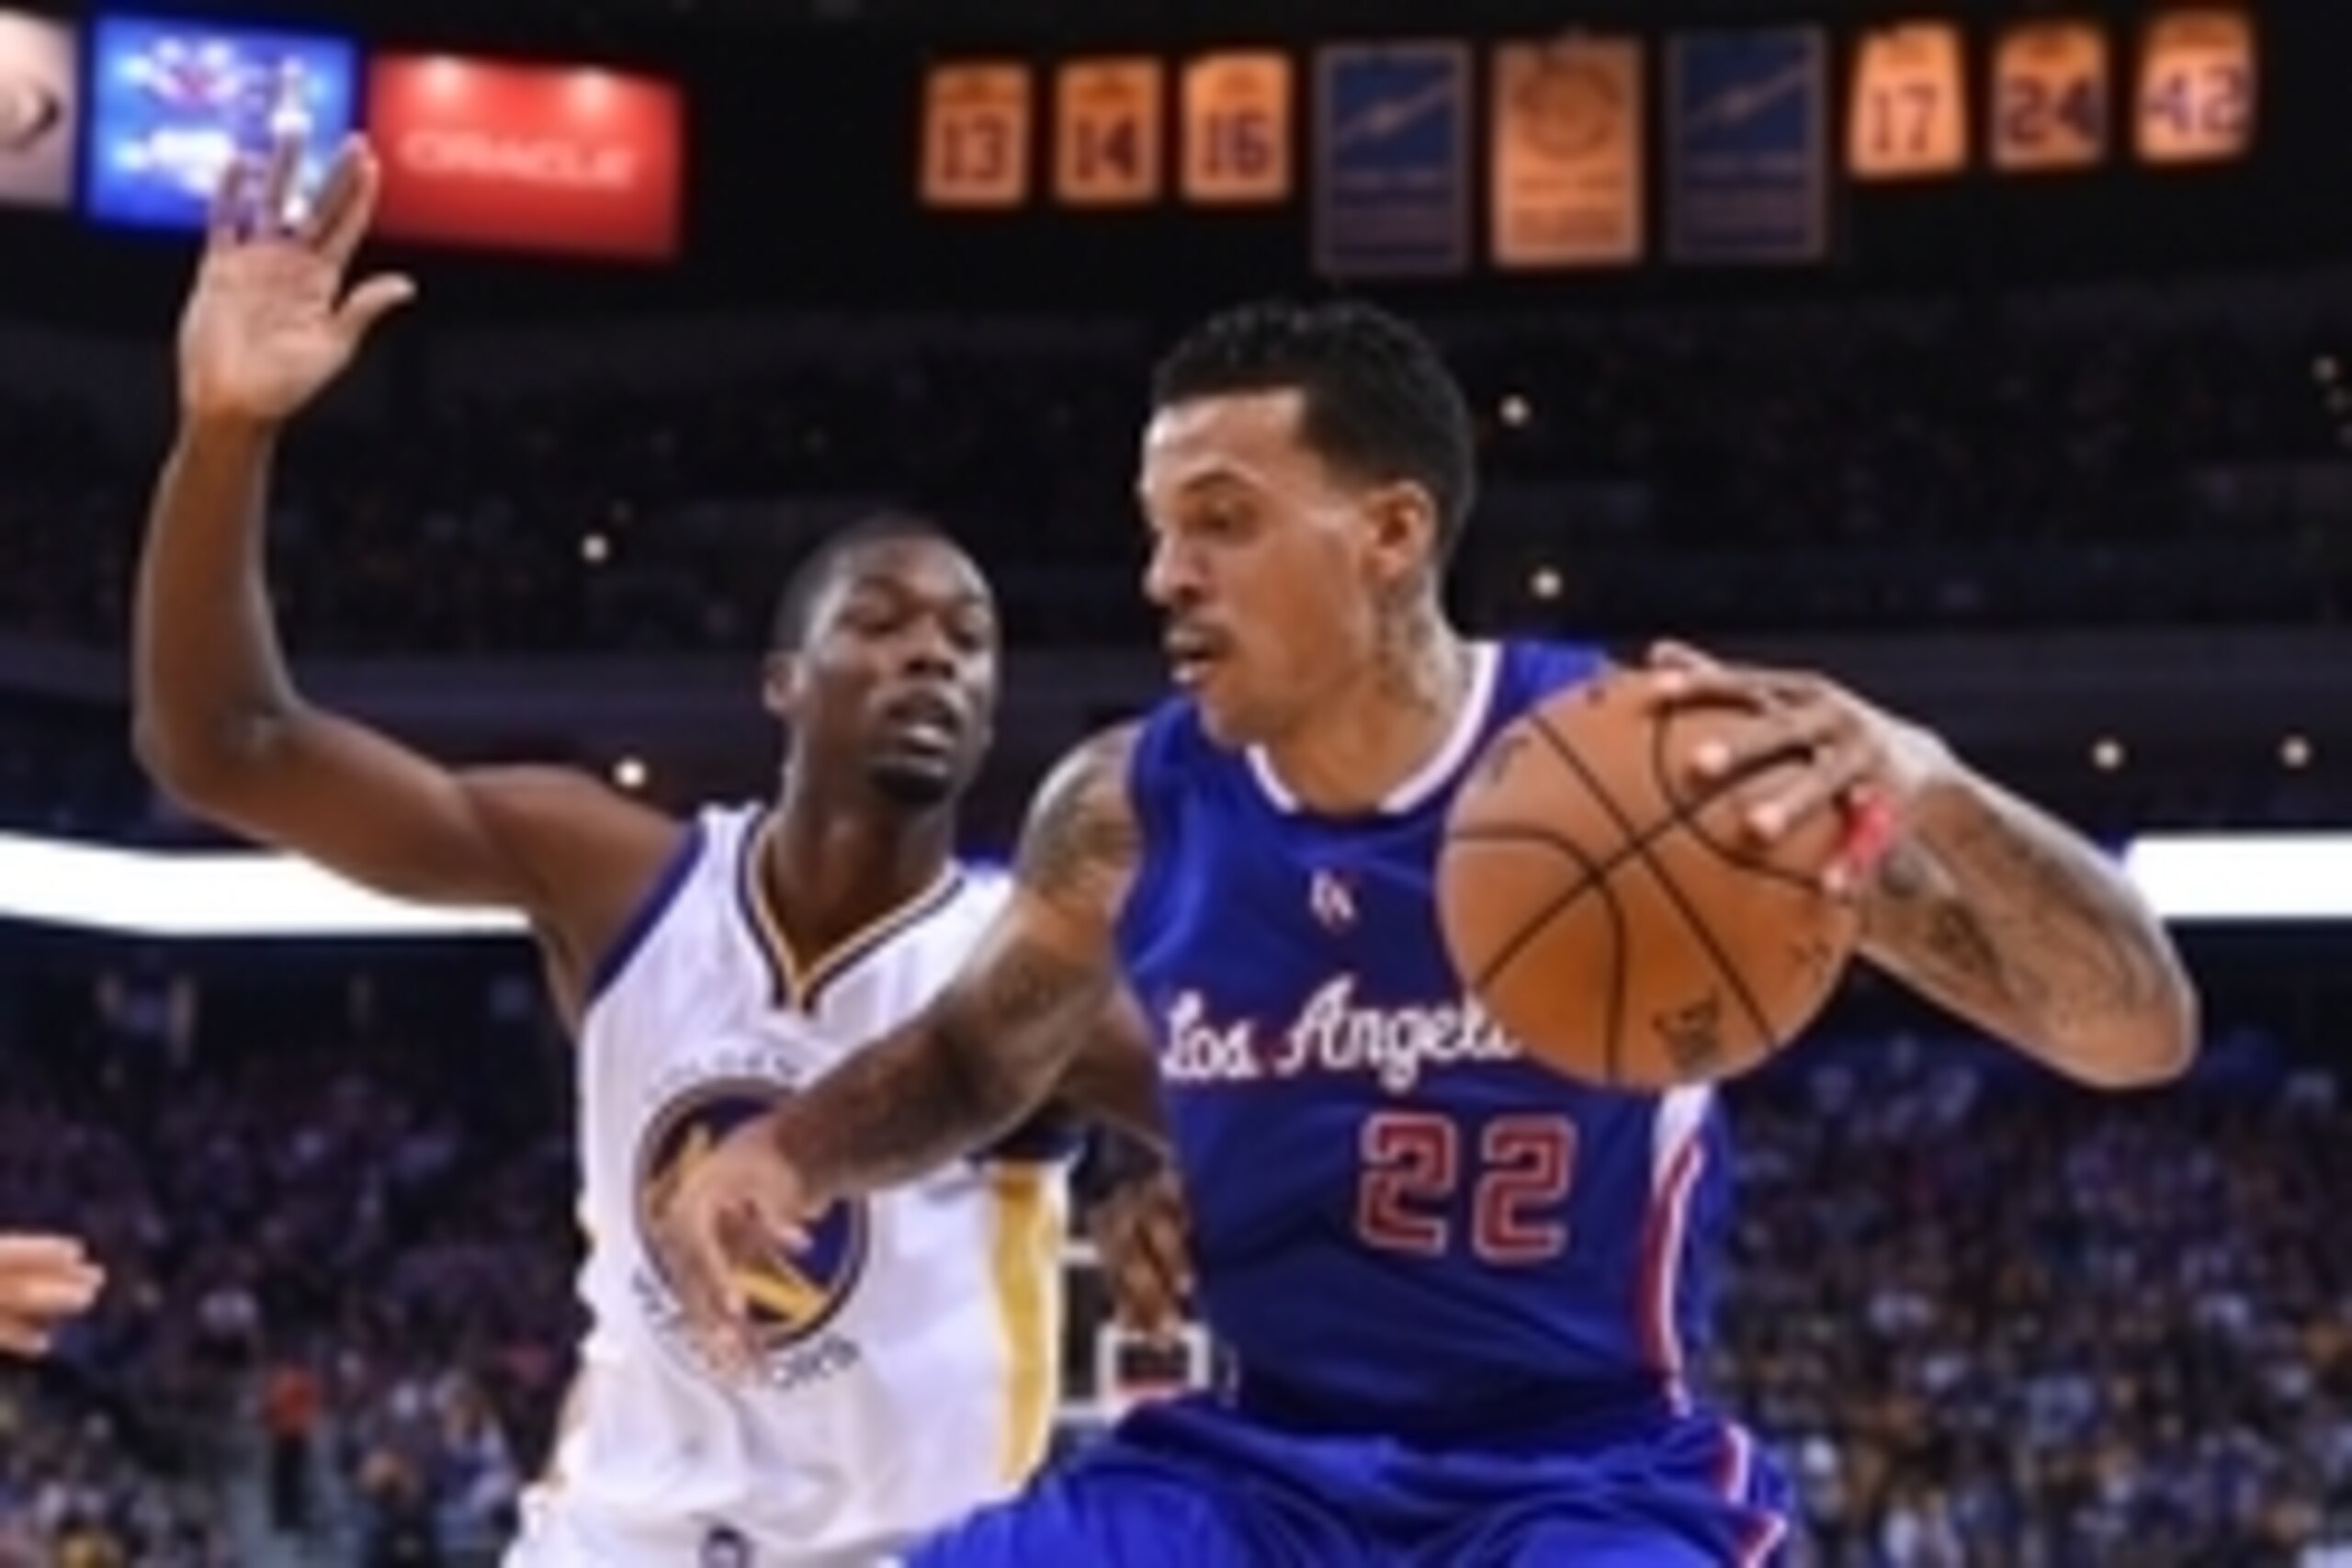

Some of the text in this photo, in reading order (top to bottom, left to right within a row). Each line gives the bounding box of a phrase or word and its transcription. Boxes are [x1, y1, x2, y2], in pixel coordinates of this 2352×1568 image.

[1870, 84, 1938, 153] 17
[2007, 75, 2101, 145] 24
[2145, 63, 2247, 134] 42
[399, 130, 634, 187] ORACLE
[941, 116, 1010, 181] 13
[1074, 118, 1138, 182] 14
[1204, 110, 1271, 179] 16
[1160, 989, 1259, 1080] Los
[1358, 1111, 1578, 1266] 22
